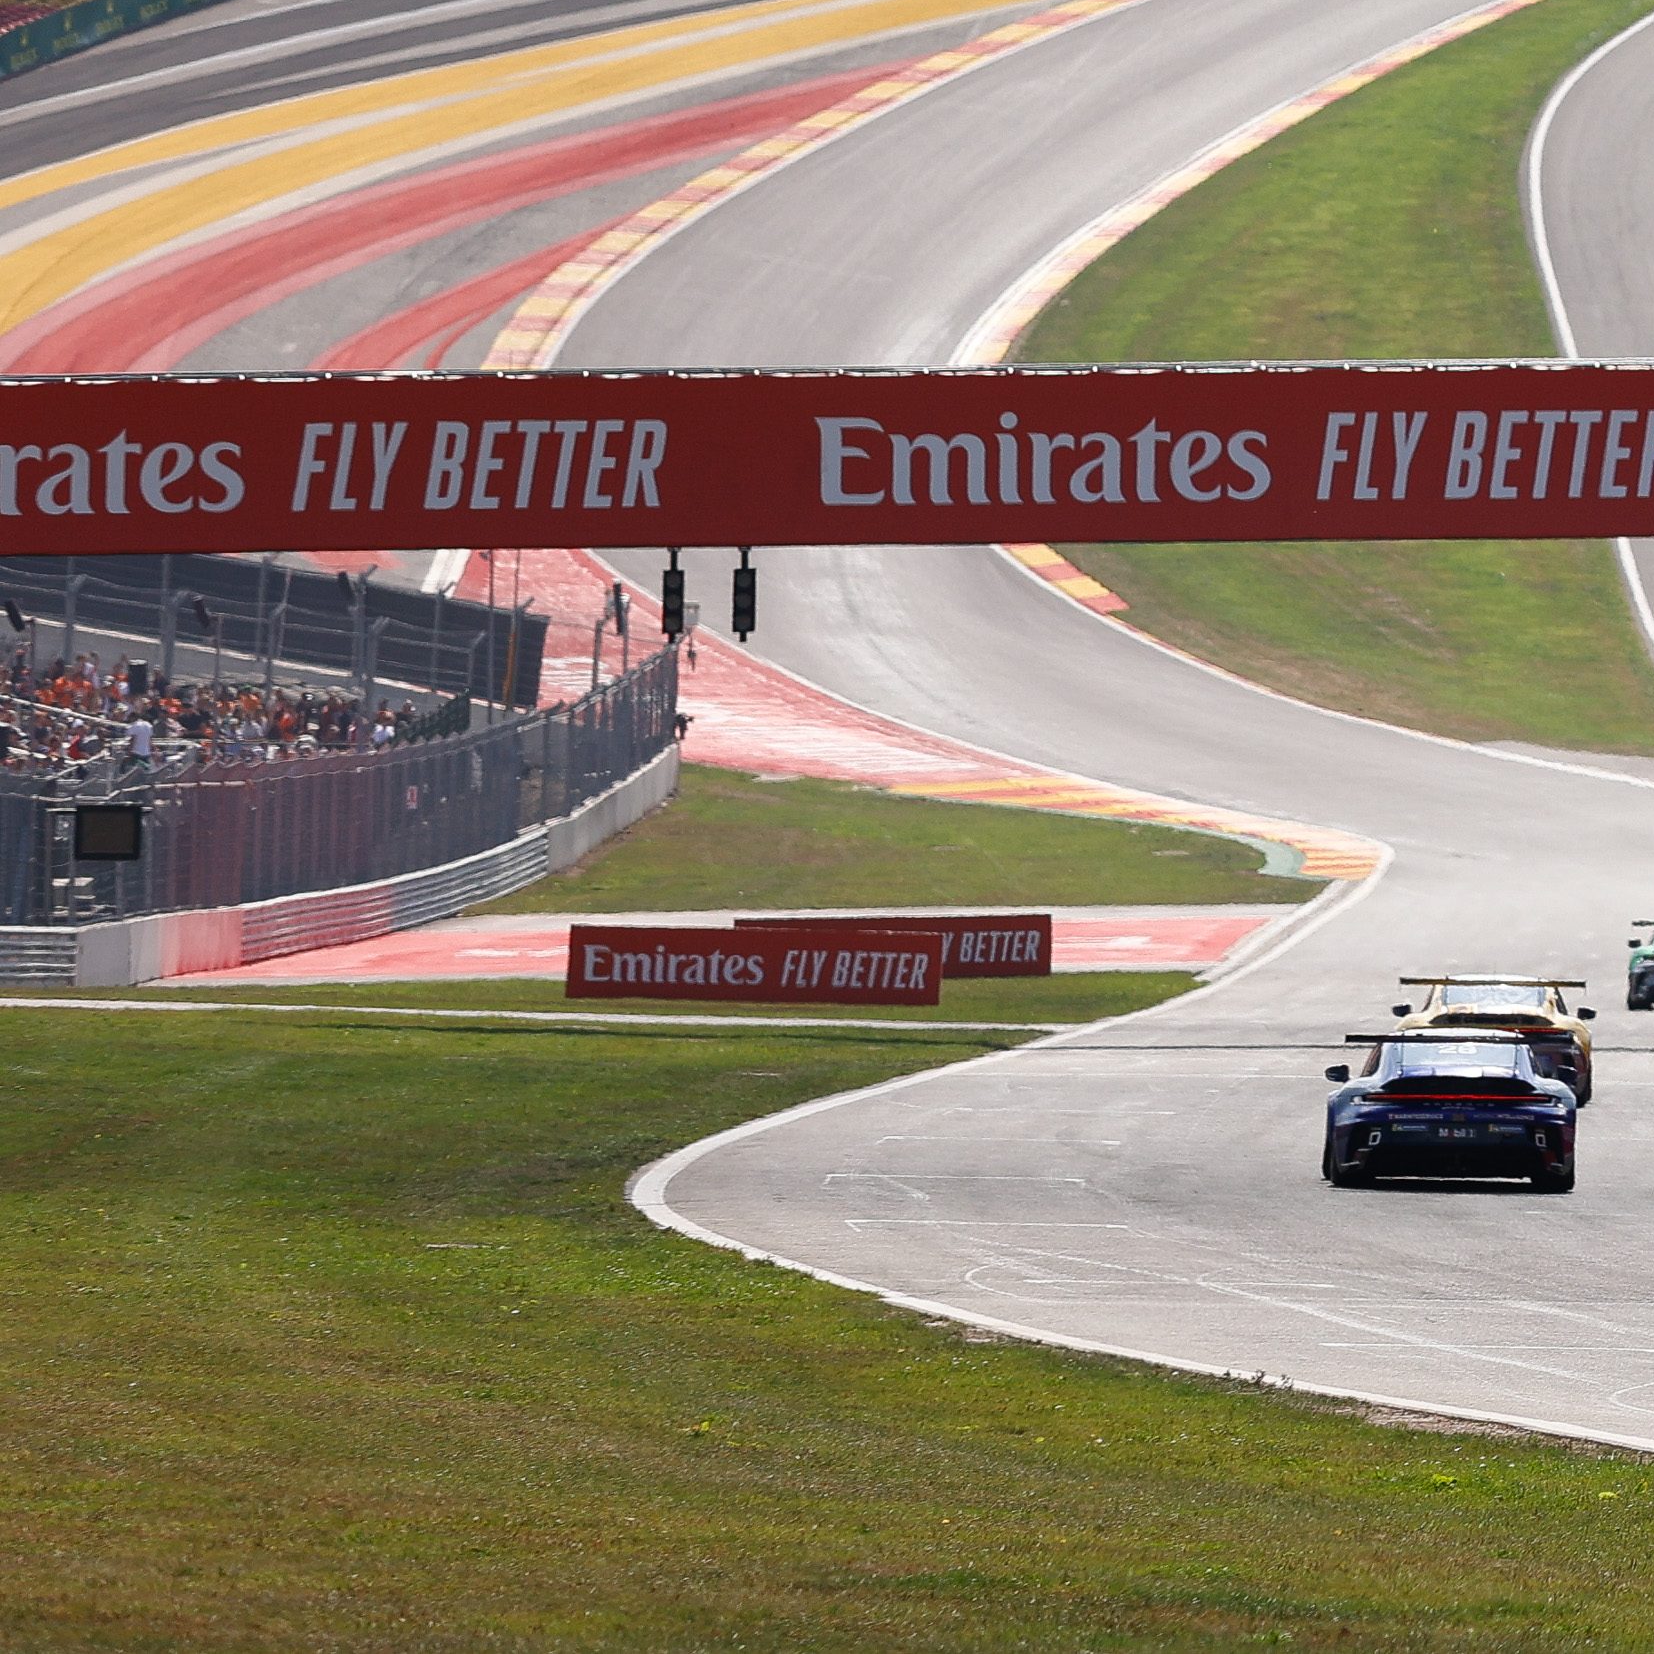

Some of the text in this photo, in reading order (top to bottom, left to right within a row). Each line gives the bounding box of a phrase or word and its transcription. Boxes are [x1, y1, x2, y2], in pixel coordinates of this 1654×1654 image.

[292, 423, 408, 512] FLY
[424, 420, 668, 511] BETTER
[817, 411, 1272, 506] Emirates
[1317, 412, 1430, 501] FLY
[583, 945, 930, 989] Emirates FLY BETTER
[959, 930, 1041, 964] BETTER
